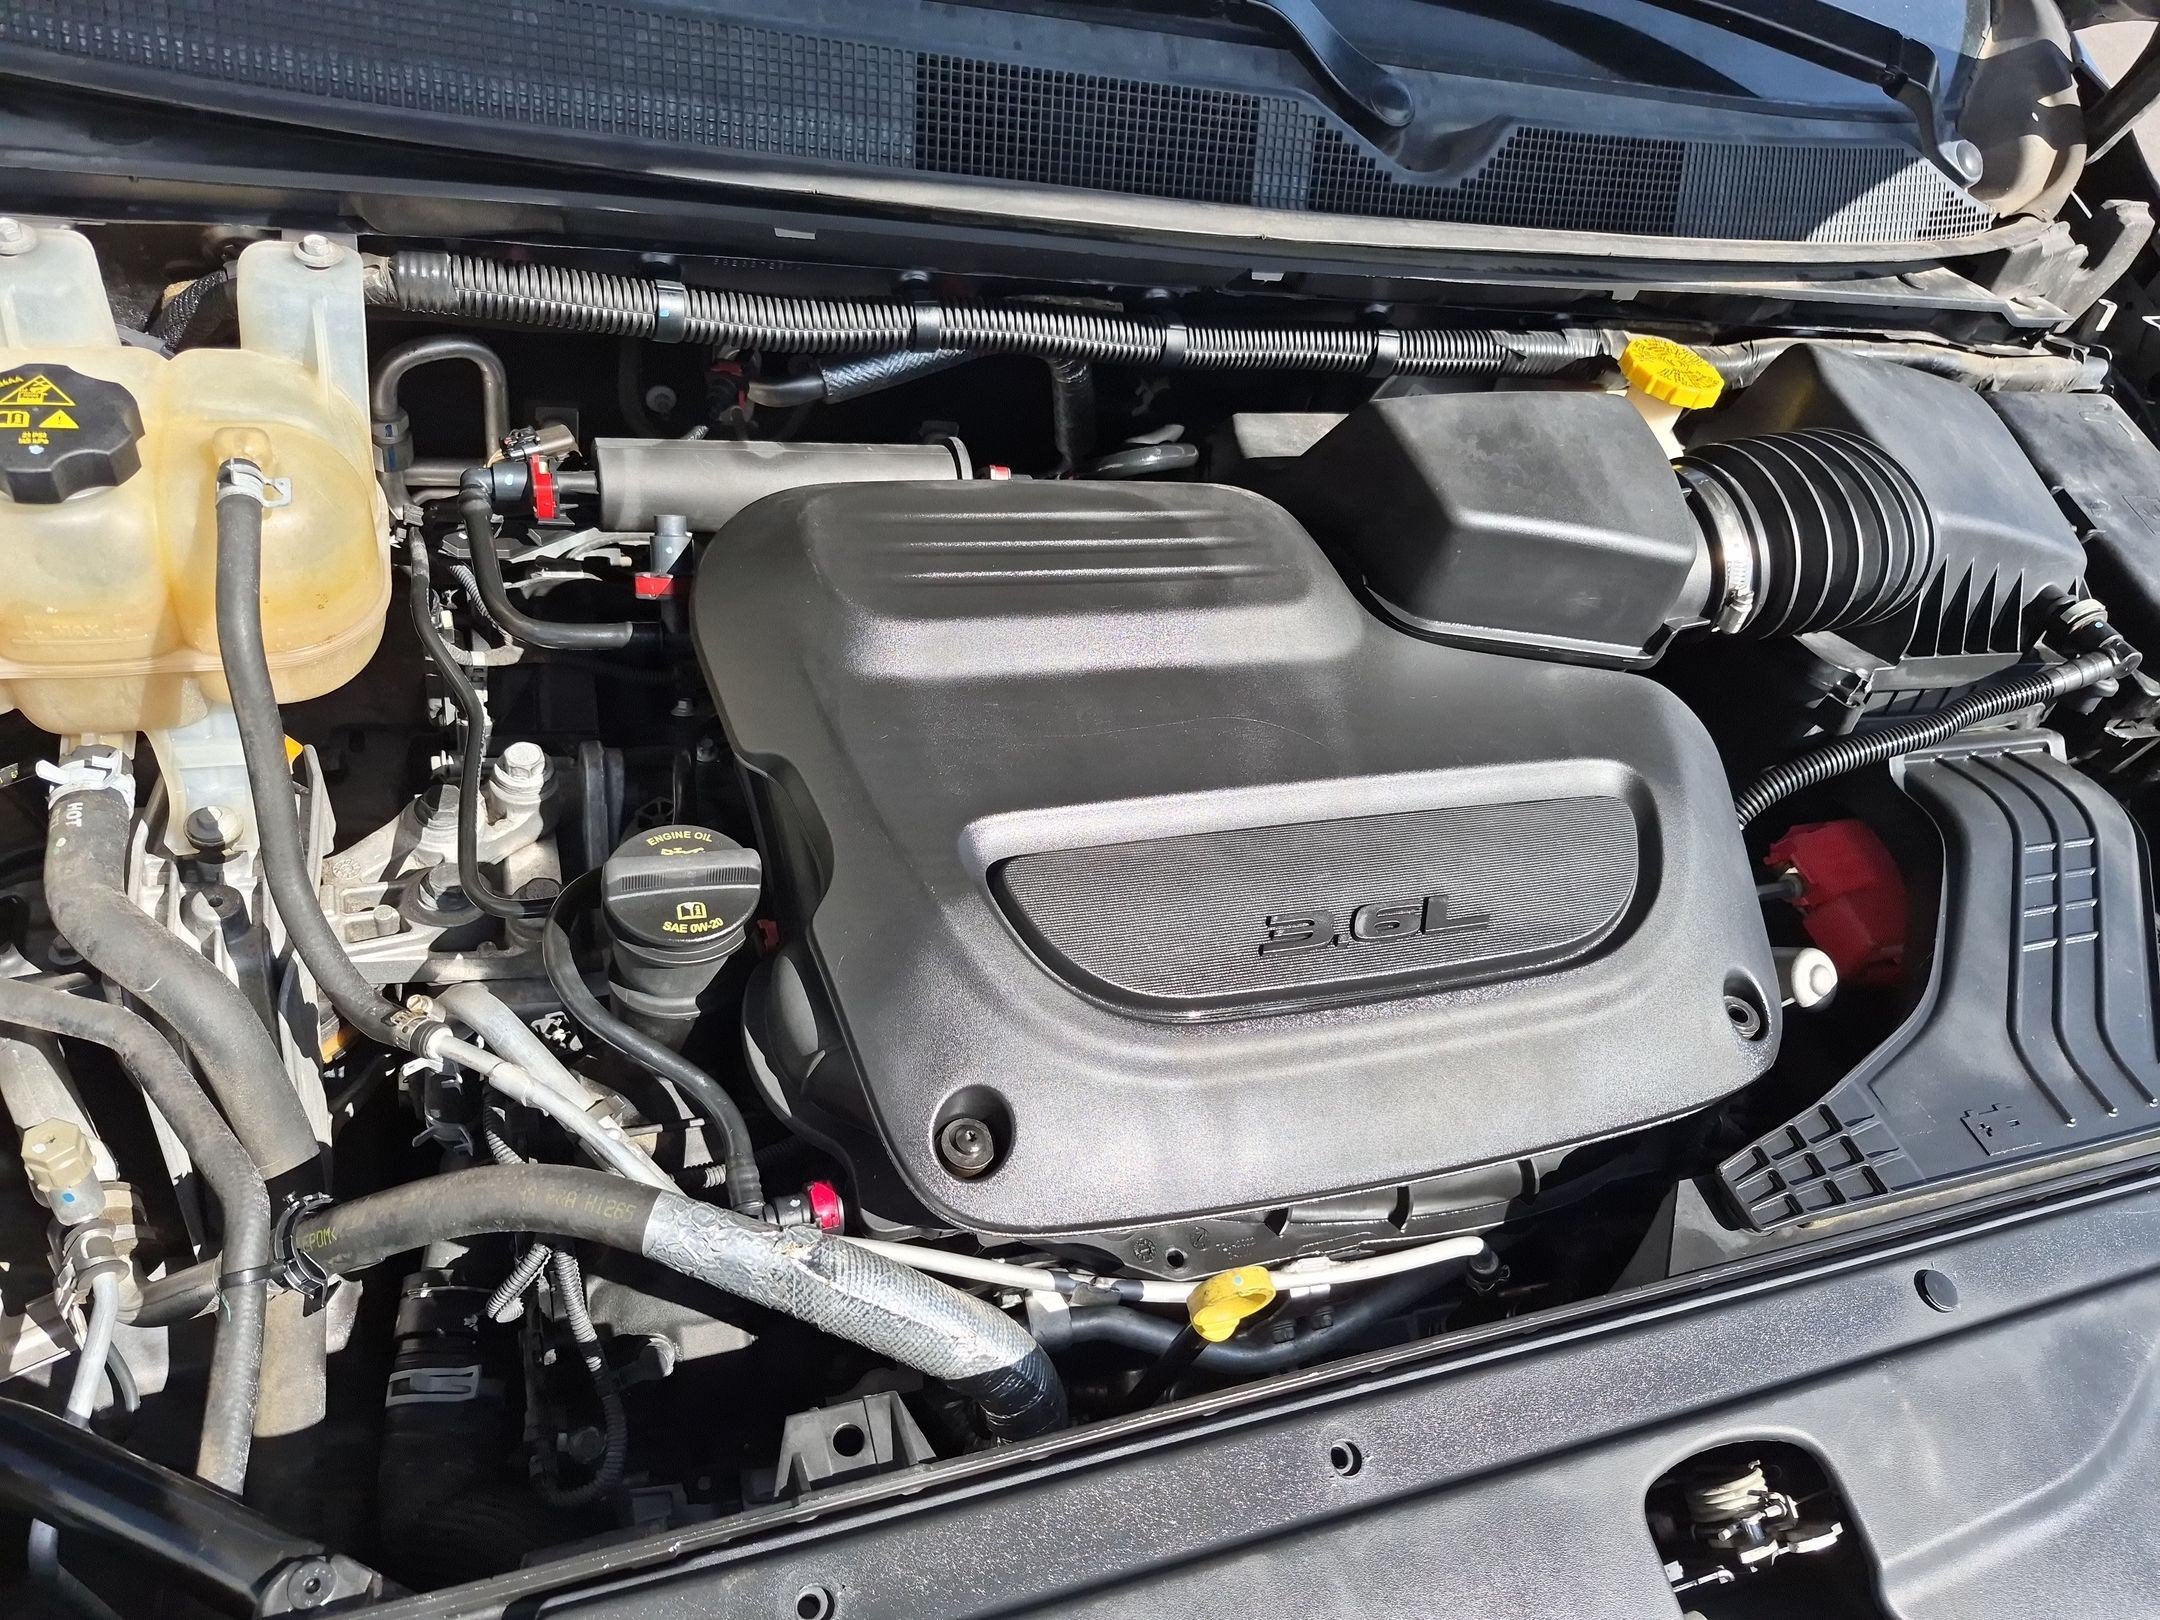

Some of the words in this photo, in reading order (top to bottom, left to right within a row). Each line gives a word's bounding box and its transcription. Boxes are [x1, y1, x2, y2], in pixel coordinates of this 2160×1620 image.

[65, 801, 84, 827] HOT
[646, 830, 691, 847] ENGINE
[694, 831, 713, 843] OIL
[662, 921, 689, 934] SAE
[690, 917, 724, 934] 0W-20
[1258, 894, 1490, 957] 3.6L
